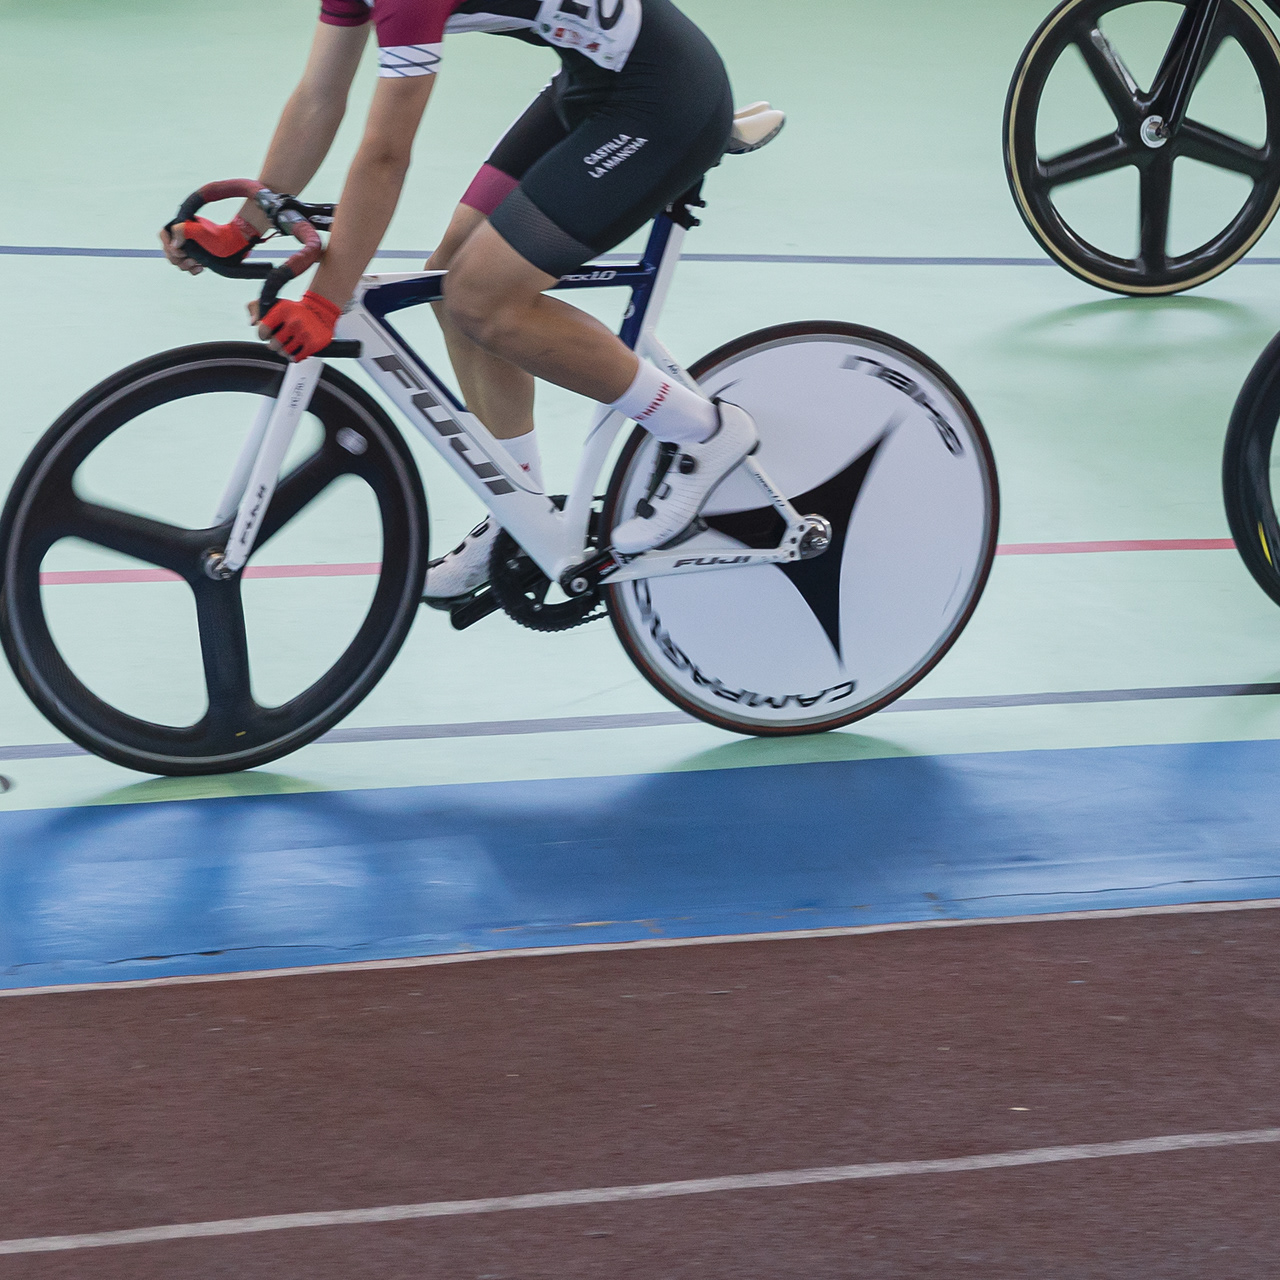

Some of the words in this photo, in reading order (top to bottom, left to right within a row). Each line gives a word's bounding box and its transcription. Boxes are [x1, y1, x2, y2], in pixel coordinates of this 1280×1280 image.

[582, 133, 633, 166] CASTILLA
[587, 166, 609, 179] LA
[371, 353, 517, 496] FUJI
[672, 555, 752, 568] FUJI
